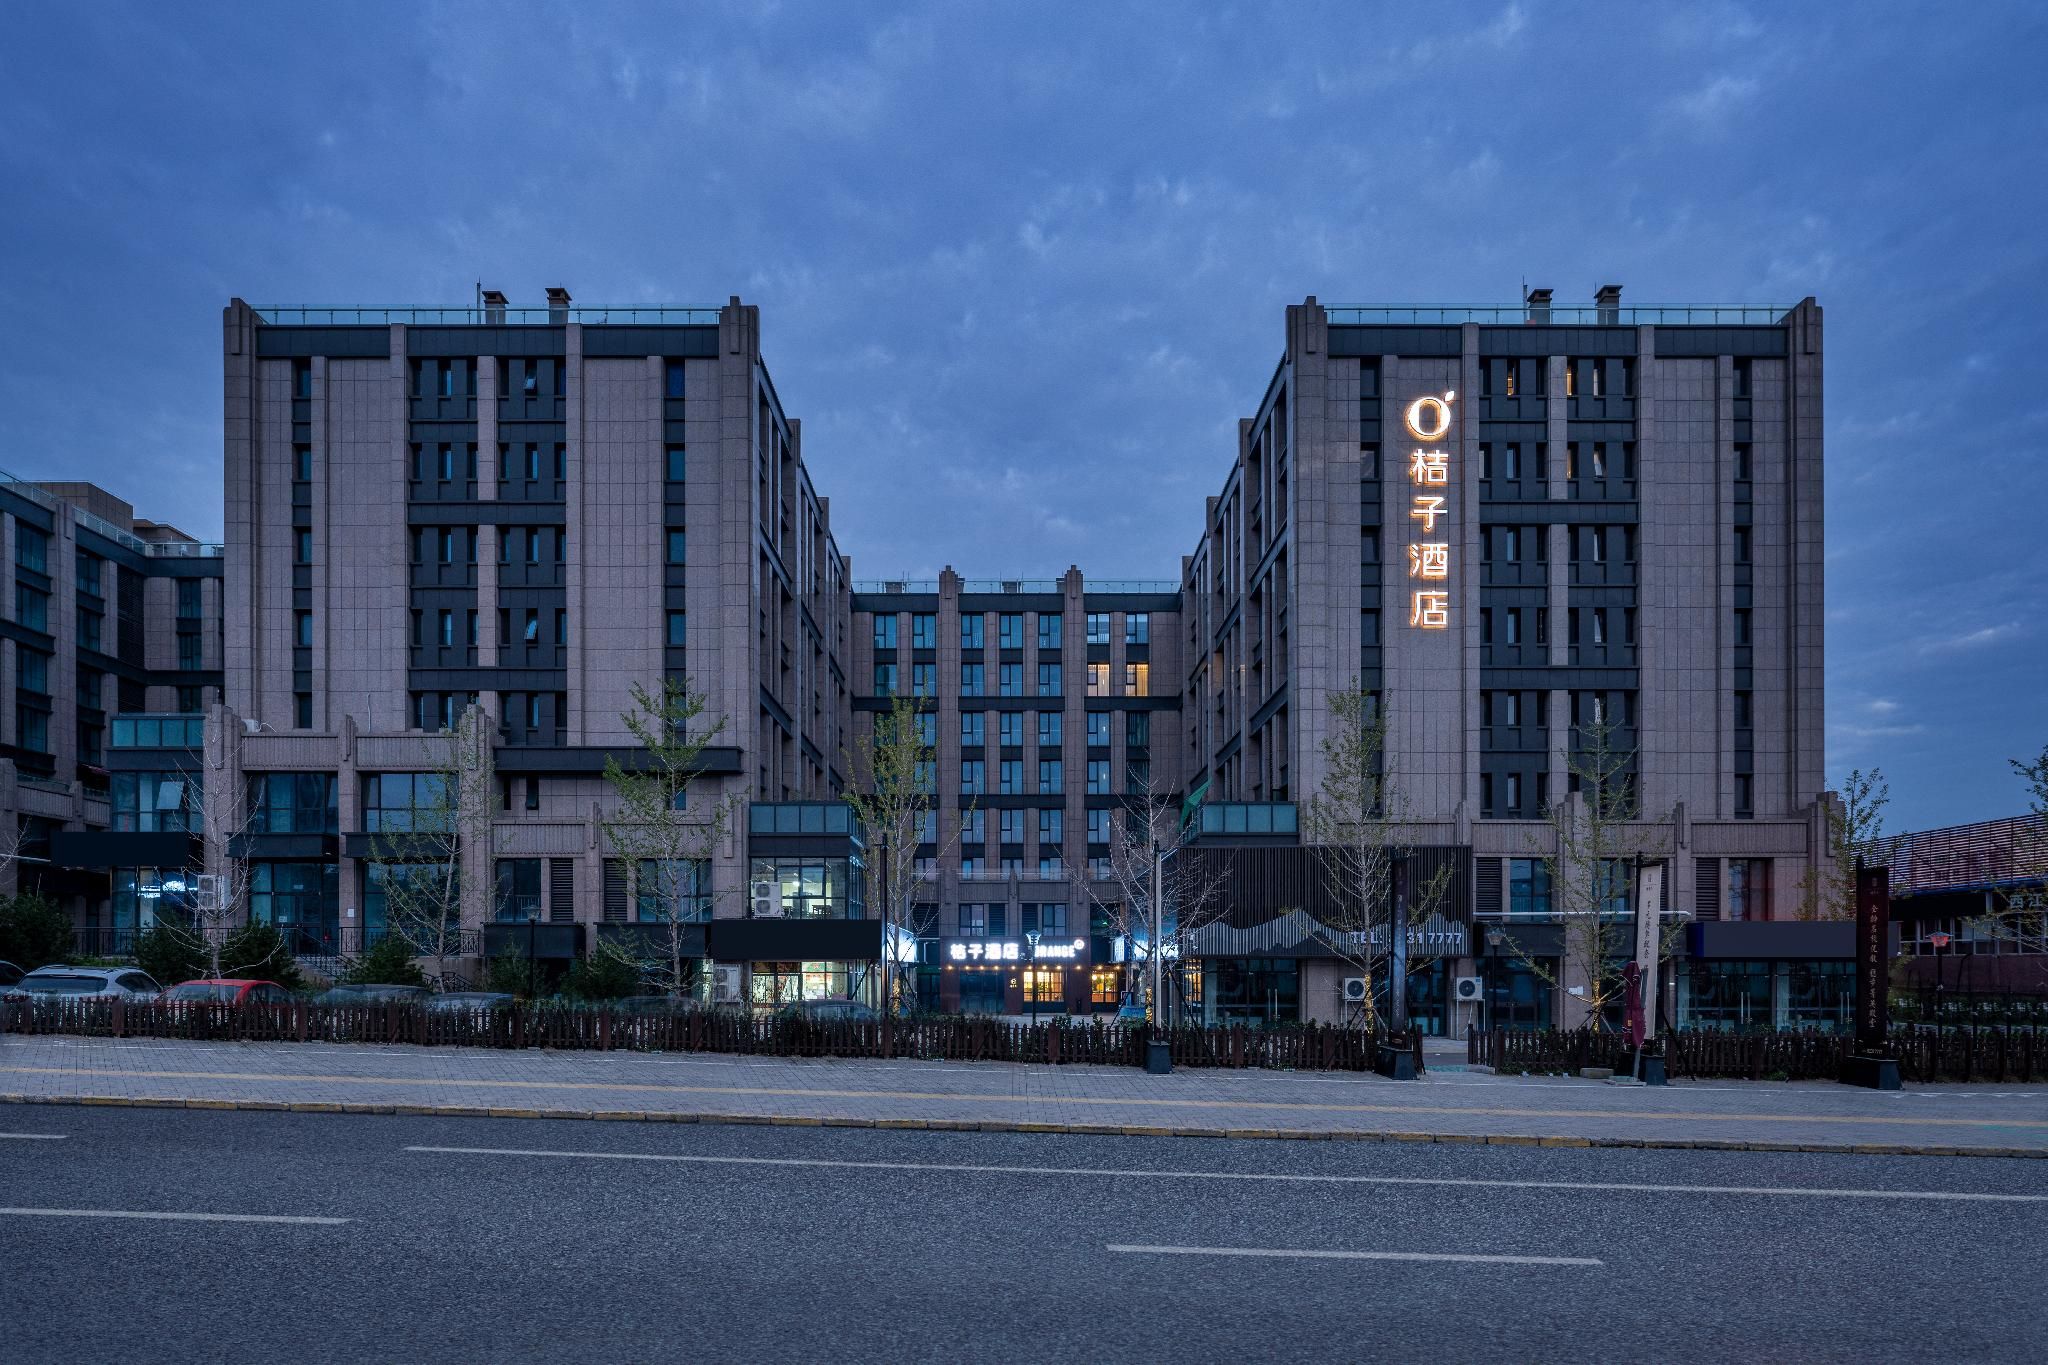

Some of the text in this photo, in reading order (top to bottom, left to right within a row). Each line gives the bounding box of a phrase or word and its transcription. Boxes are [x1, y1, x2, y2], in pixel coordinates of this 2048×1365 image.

[1410, 448, 1449, 627] 桔子酒店
[950, 943, 1019, 960] 桔子酒店
